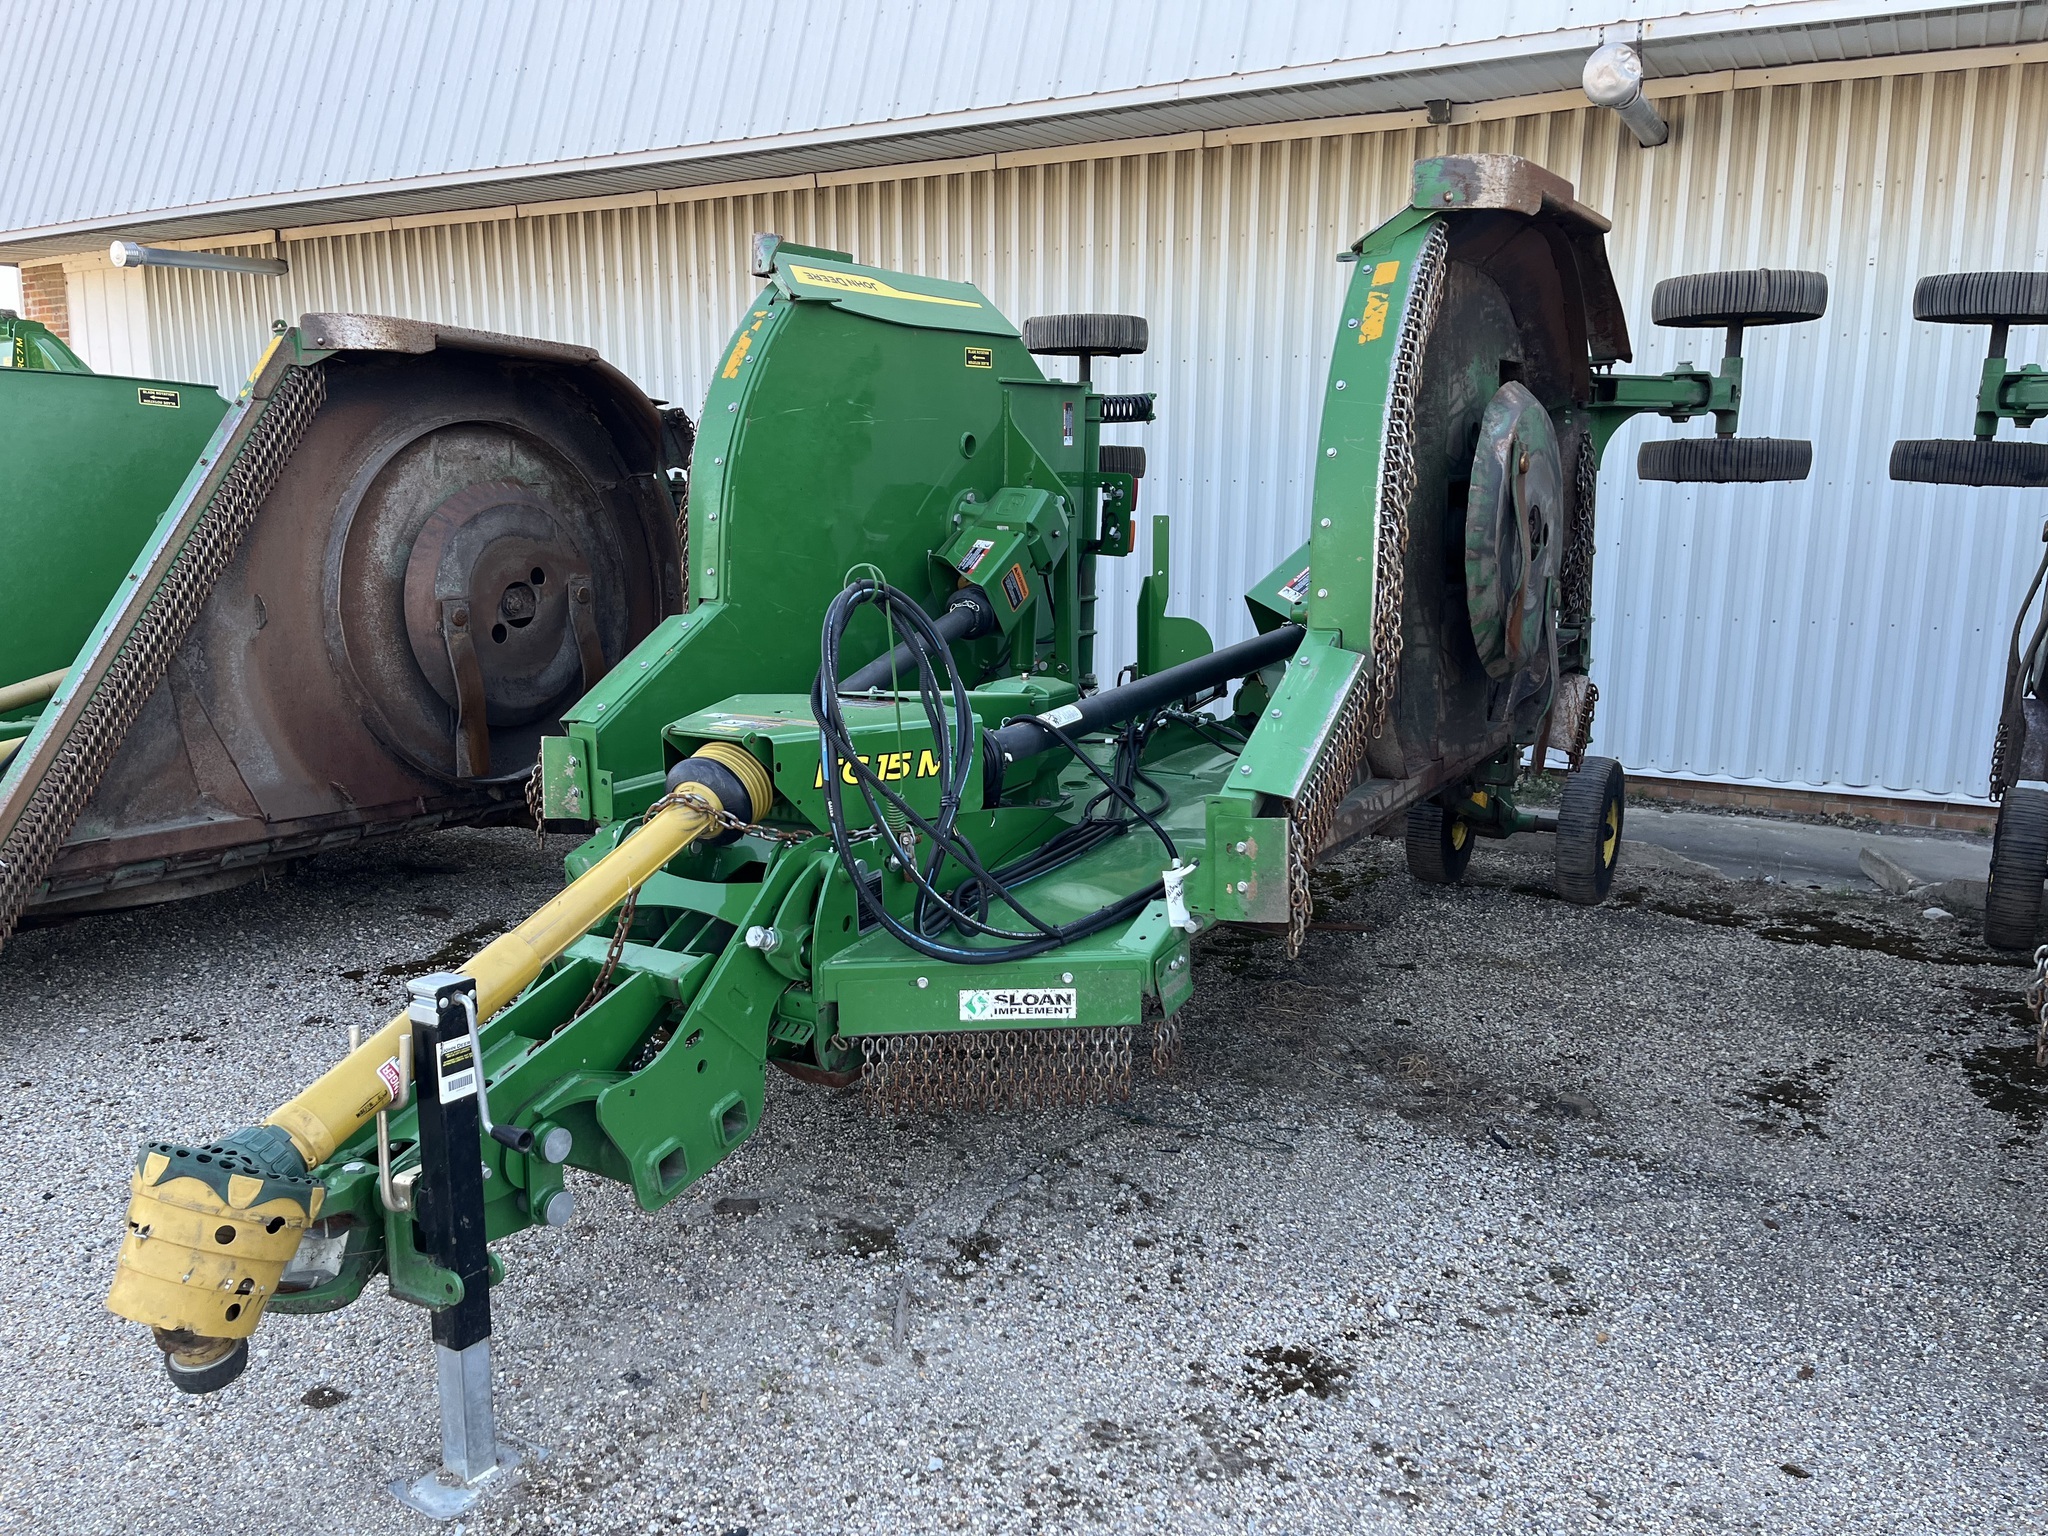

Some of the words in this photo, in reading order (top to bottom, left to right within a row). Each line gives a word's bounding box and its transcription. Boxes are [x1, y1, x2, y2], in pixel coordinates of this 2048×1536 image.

[803, 271, 848, 286] DEERE
[847, 278, 878, 292] JOHN
[877, 751, 914, 782] 15
[994, 993, 1072, 1006] SLOAN
[994, 1006, 1073, 1015] IMPLEMENT
